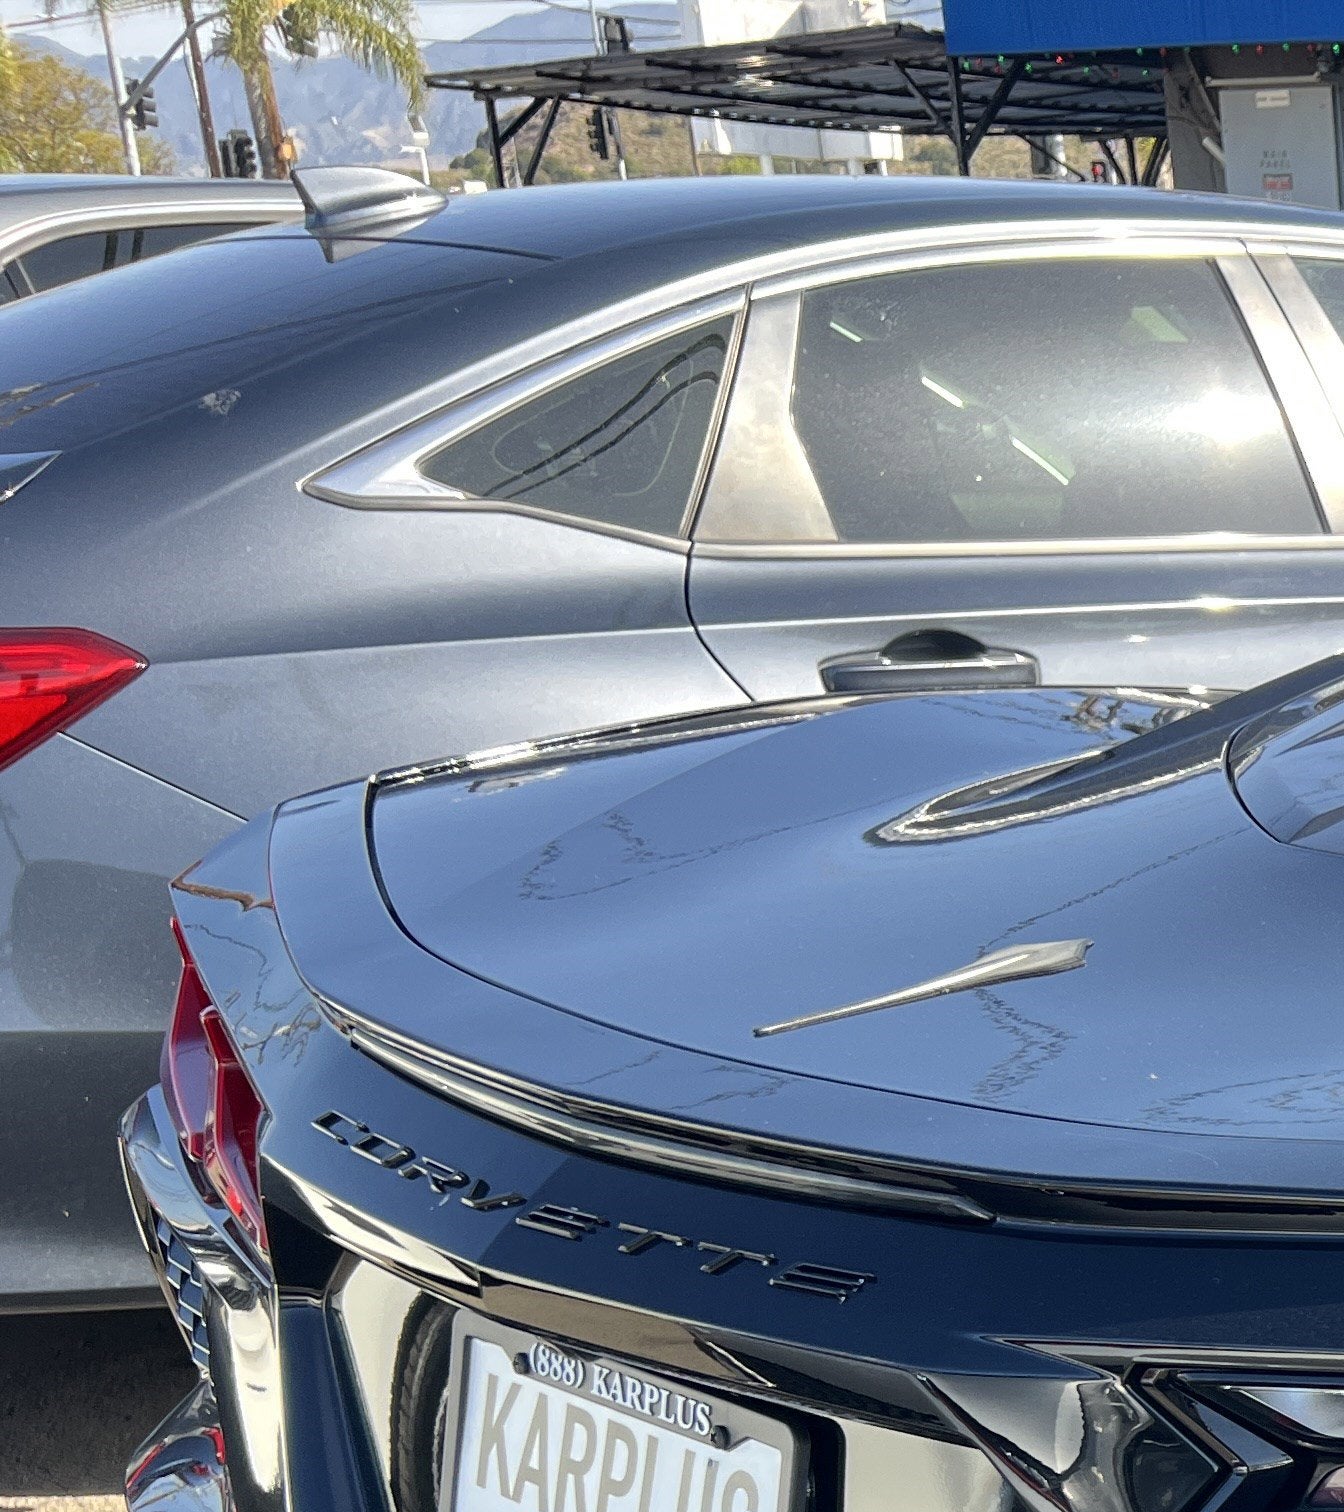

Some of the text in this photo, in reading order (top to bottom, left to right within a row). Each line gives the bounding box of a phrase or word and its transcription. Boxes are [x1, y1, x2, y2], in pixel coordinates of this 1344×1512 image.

[310, 1108, 878, 1305] CORVETTE
[527, 1342, 714, 1437] (888) KARPLUS
